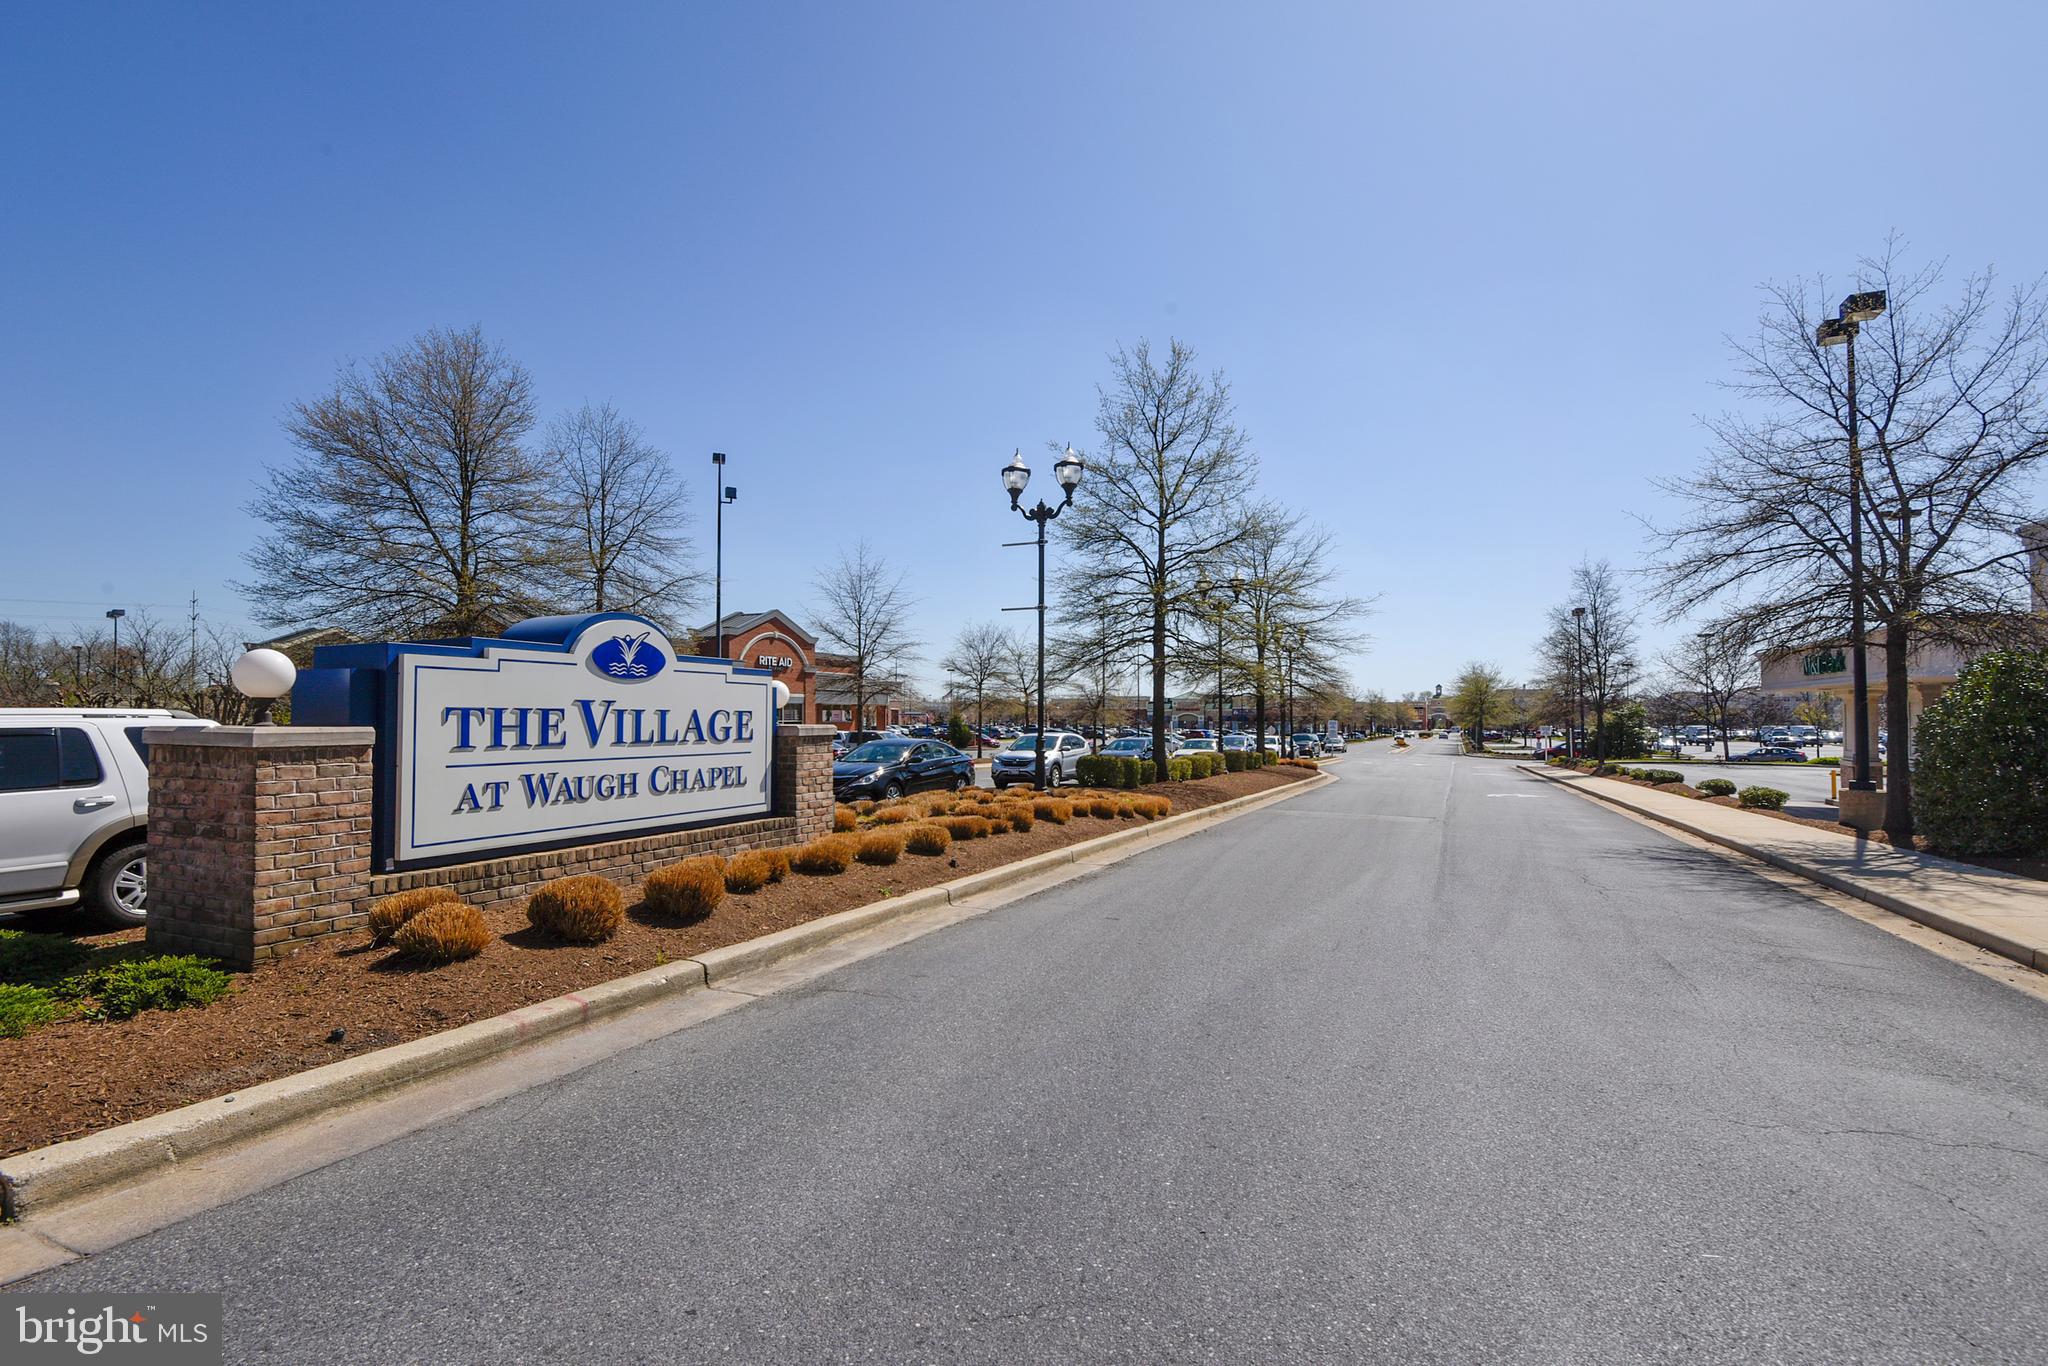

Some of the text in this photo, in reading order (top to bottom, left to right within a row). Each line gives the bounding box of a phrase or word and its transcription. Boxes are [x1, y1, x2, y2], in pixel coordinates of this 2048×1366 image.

[759, 655, 793, 667] RITE AID
[442, 699, 754, 752] THE VILLAGE
[452, 765, 748, 815] AT WAUGH CHAPEL
